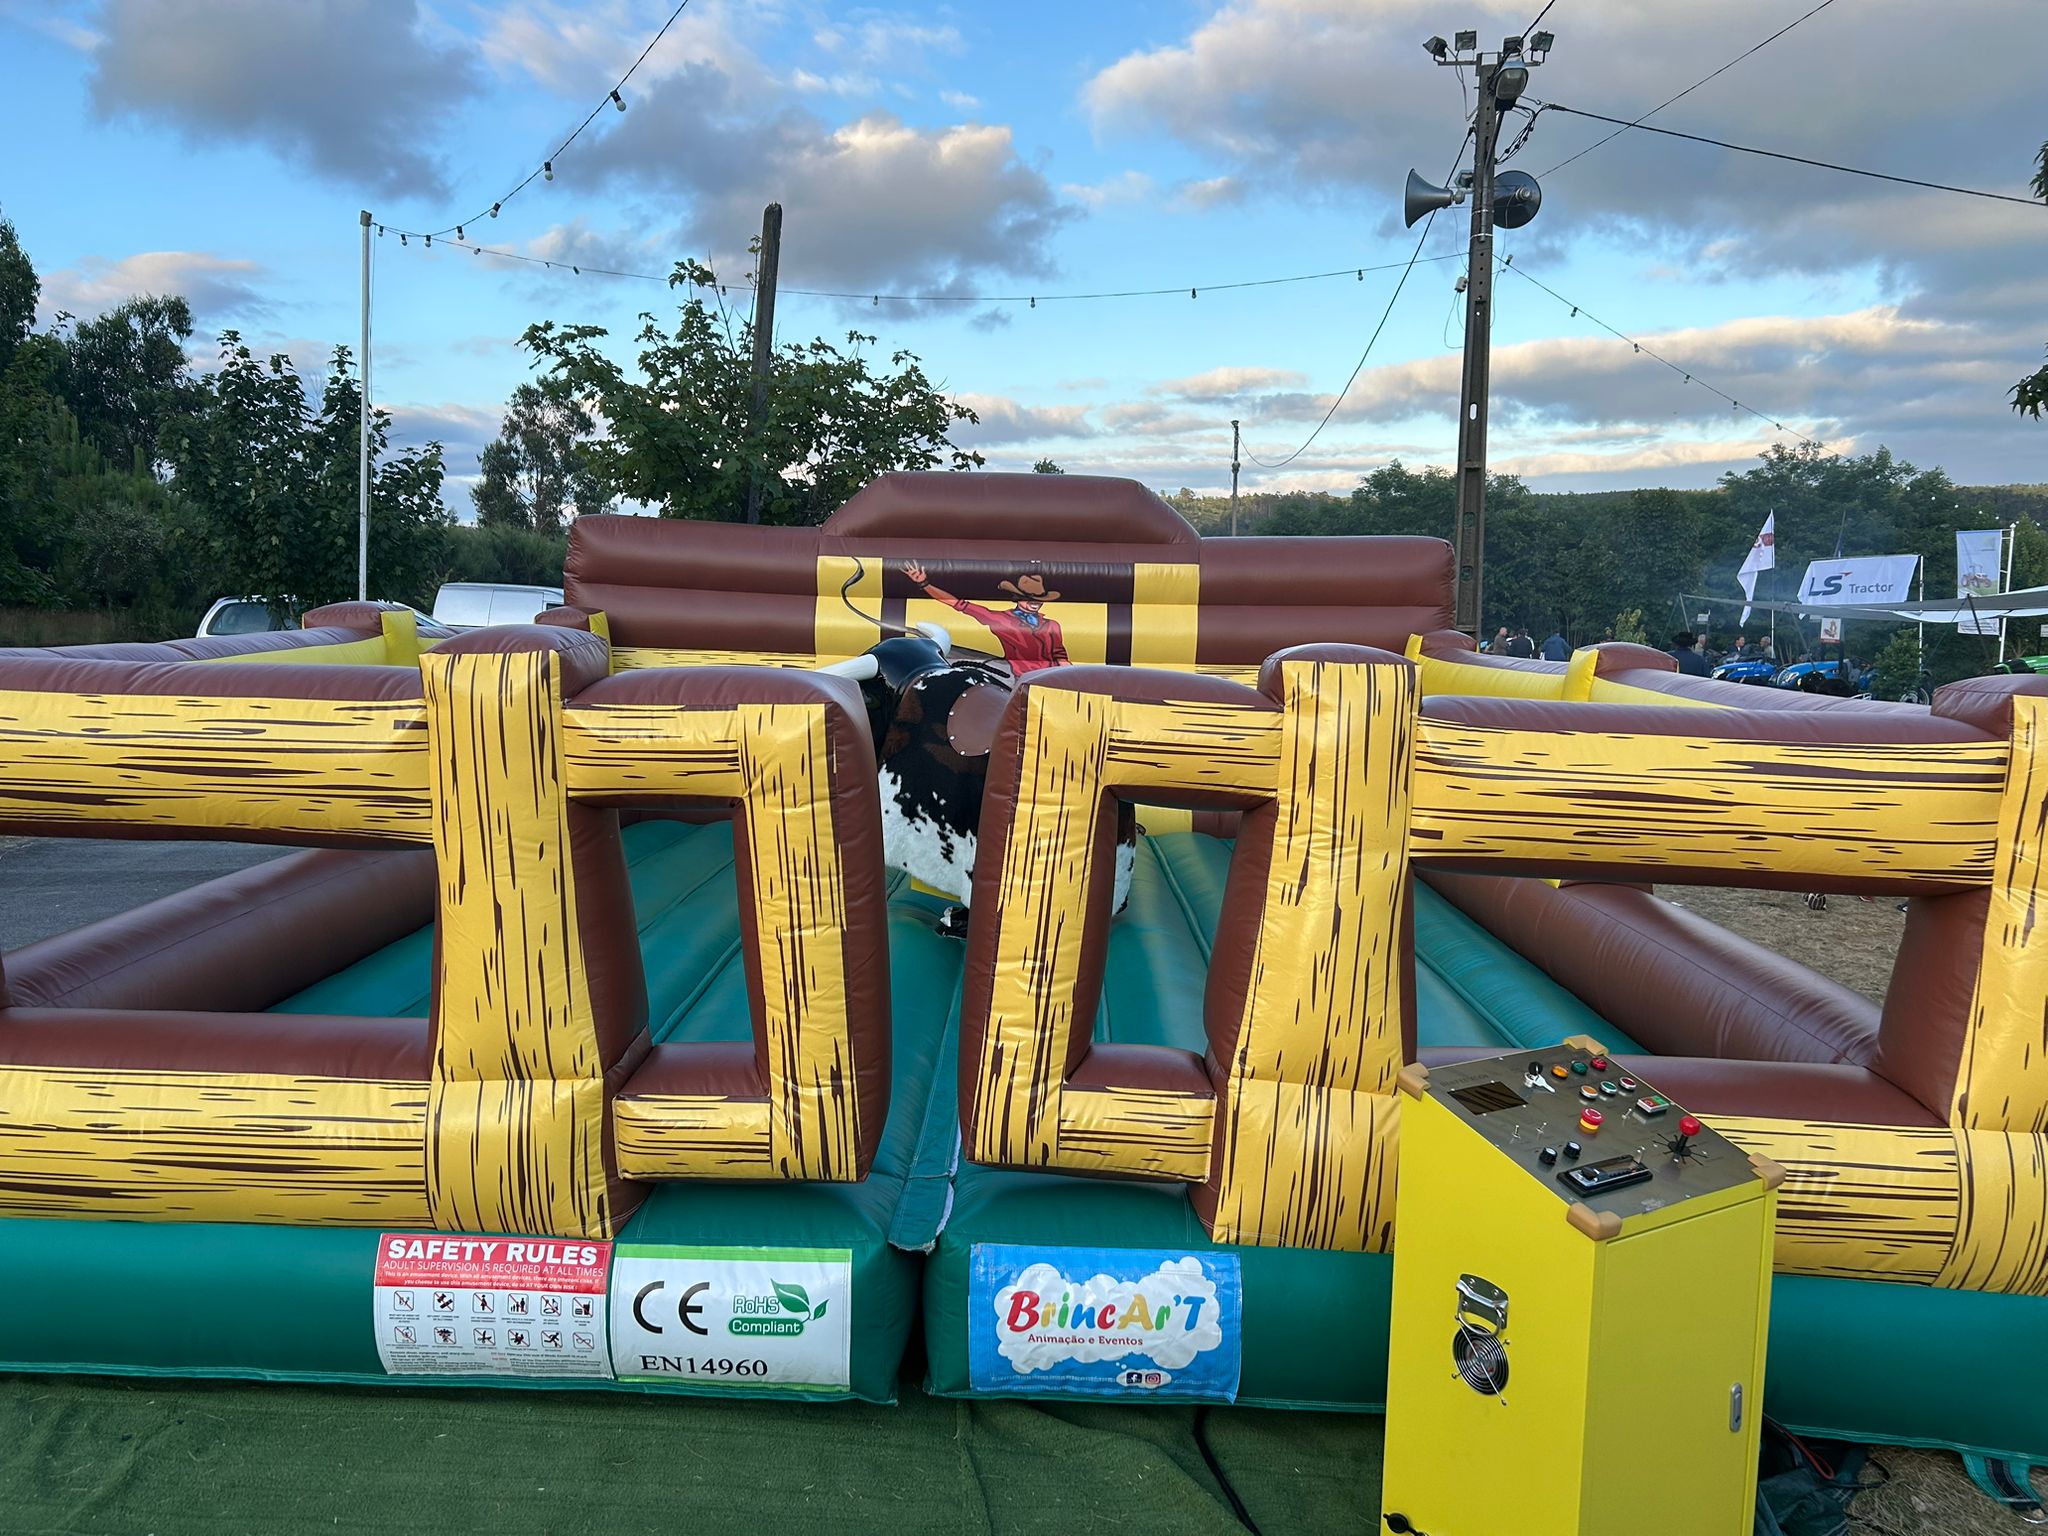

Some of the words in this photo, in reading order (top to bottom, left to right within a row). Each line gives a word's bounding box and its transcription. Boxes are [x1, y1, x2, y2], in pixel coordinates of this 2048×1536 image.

[1808, 575, 1843, 597] LS
[1849, 583, 1894, 594] Tractor
[388, 1239, 499, 1261] SAFETY
[506, 1242, 598, 1266] RULES
[383, 1260, 416, 1270] ADULT
[417, 1261, 479, 1272] SUPERVISION
[481, 1263, 490, 1272] IS
[492, 1263, 541, 1274] REQUIRED
[543, 1265, 555, 1275] AT
[556, 1266, 573, 1276] ALL
[575, 1267, 604, 1277] TIMES
[633, 1281, 711, 1335] CE
[733, 1295, 780, 1315] RoHS
[732, 1319, 801, 1335] Compliant
[1028, 1333, 1086, 1346] Animação
[1098, 1335, 1144, 1347] Eventos
[640, 1355, 769, 1377] EN14960
